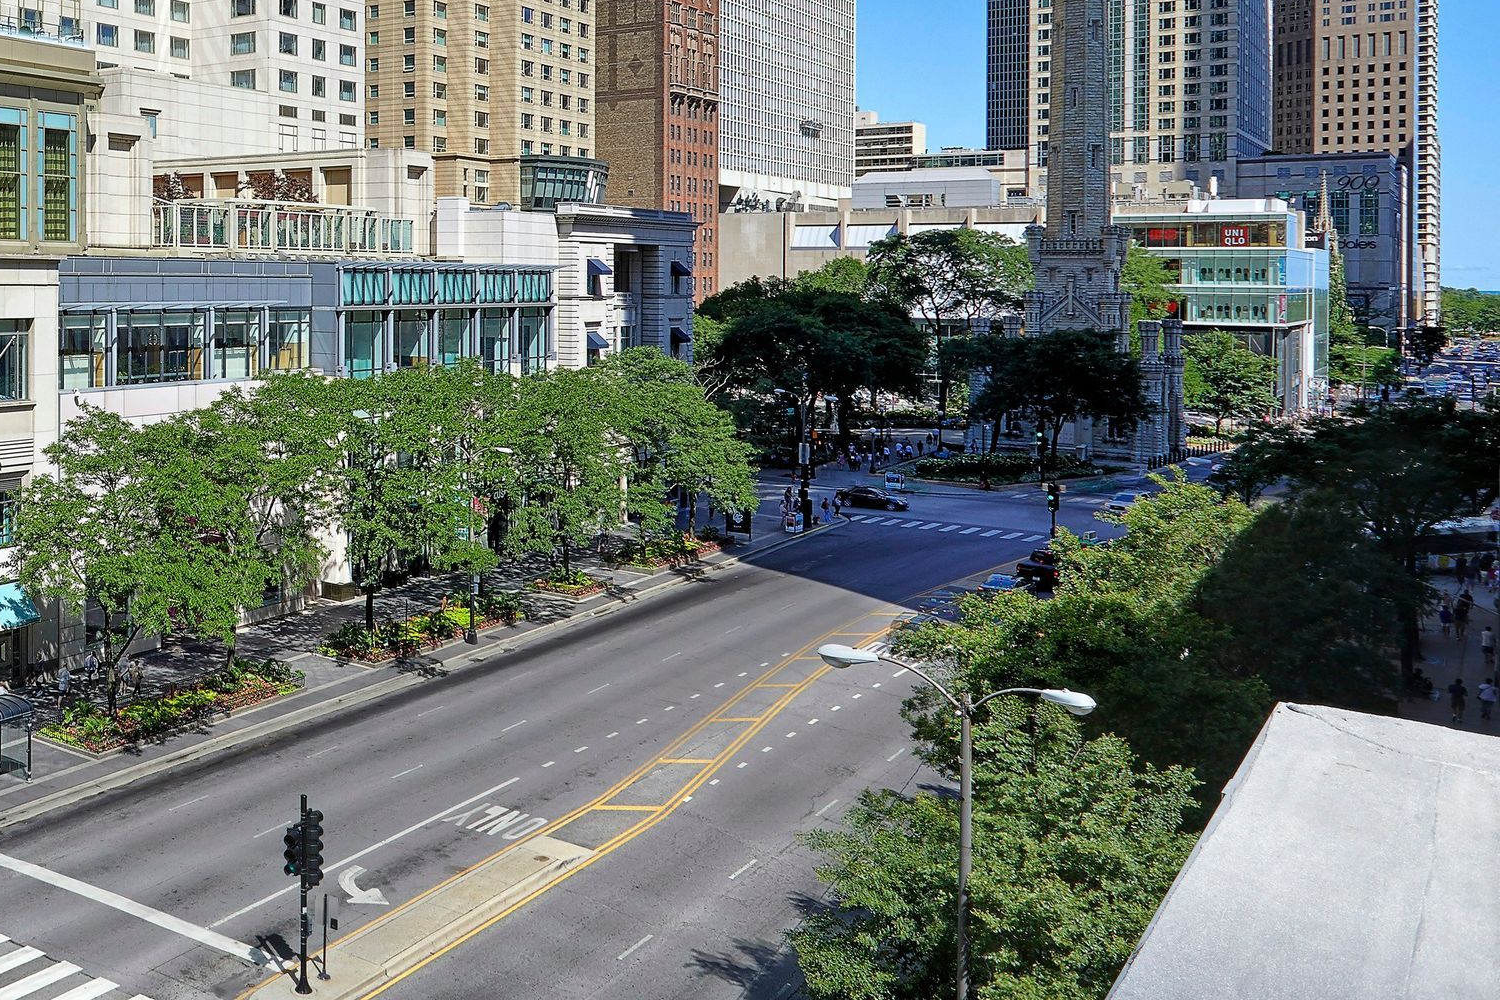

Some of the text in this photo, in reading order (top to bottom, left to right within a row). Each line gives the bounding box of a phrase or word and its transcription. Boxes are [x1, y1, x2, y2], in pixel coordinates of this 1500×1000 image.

[1337, 175, 1380, 190] 900
[1224, 229, 1244, 237] UNI
[1224, 237, 1246, 246] QLO
[441, 803, 548, 840] ONLY
